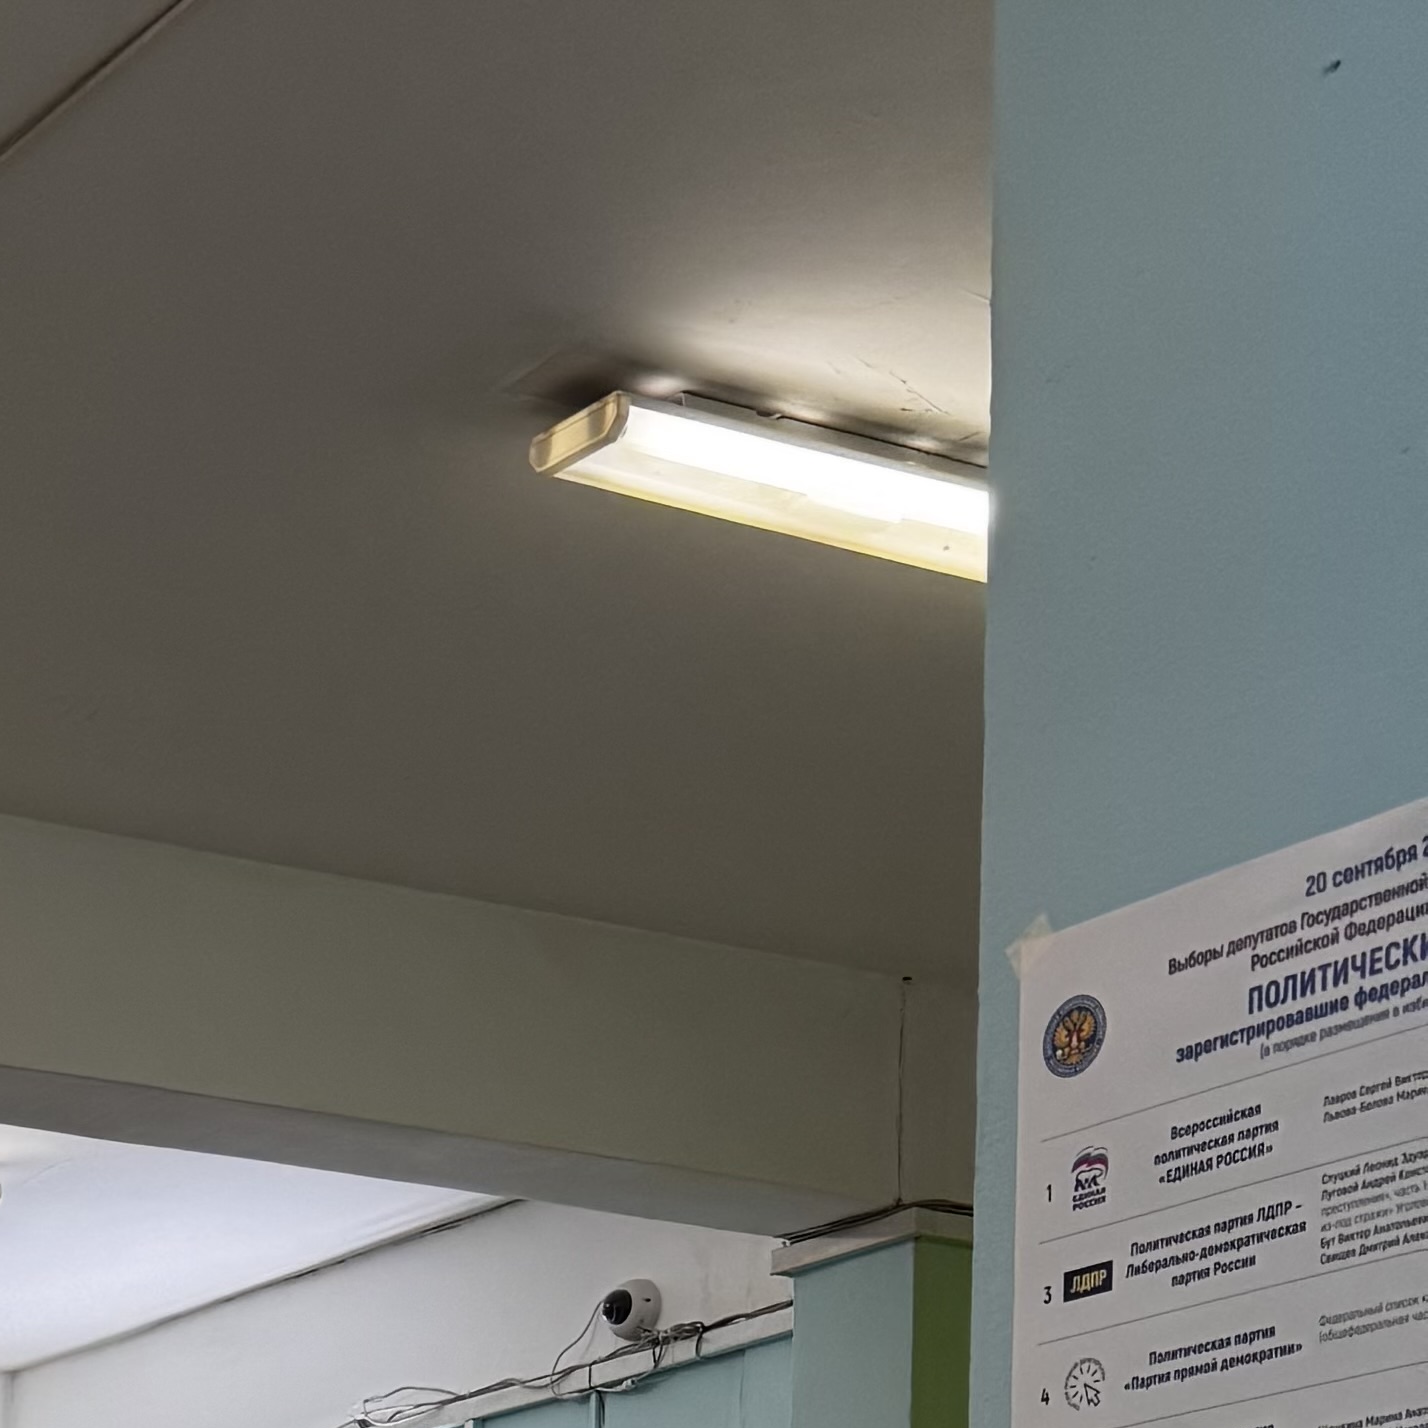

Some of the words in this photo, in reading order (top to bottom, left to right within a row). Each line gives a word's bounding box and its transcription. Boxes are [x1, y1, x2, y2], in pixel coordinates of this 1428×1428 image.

[1305, 871, 1327, 897] 20
[1332, 843, 1418, 888] сентября
[1168, 944, 1224, 976] Выборы
[1226, 919, 1298, 958] депутатов
[1250, 927, 1340, 971] Российской
[1175, 994, 1350, 1063] зарегистрировавшие
[1154, 1130, 1235, 1166] политическая
[1237, 1119, 1279, 1144] партия
[1171, 1103, 1262, 1140] Всероссийская
[1159, 1157, 1213, 1184] «ЕДИНАЯ
[1216, 1141, 1274, 1169] РОССИЯ»
[1046, 1184, 1052, 1202] 1
[1125, 1220, 1307, 1279] Либерально-демократическая
[1130, 1224, 1211, 1257] Политическая
[1213, 1211, 1254, 1236] партия
[1256, 1200, 1293, 1223] ЛДПР
[1070, 1270, 1107, 1294] ЛДПР
[1171, 1266, 1211, 1288] партия
[1213, 1254, 1256, 1277] России
[1043, 1285, 1052, 1304] 3
[1149, 1333, 1232, 1366] Политическая
[1234, 1325, 1276, 1348] партия
[1124, 1369, 1171, 1392] «Партия
[1174, 1357, 1218, 1383] прямой
[1220, 1343, 1303, 1372] демократии»
[1040, 1388, 1050, 1405] 4
